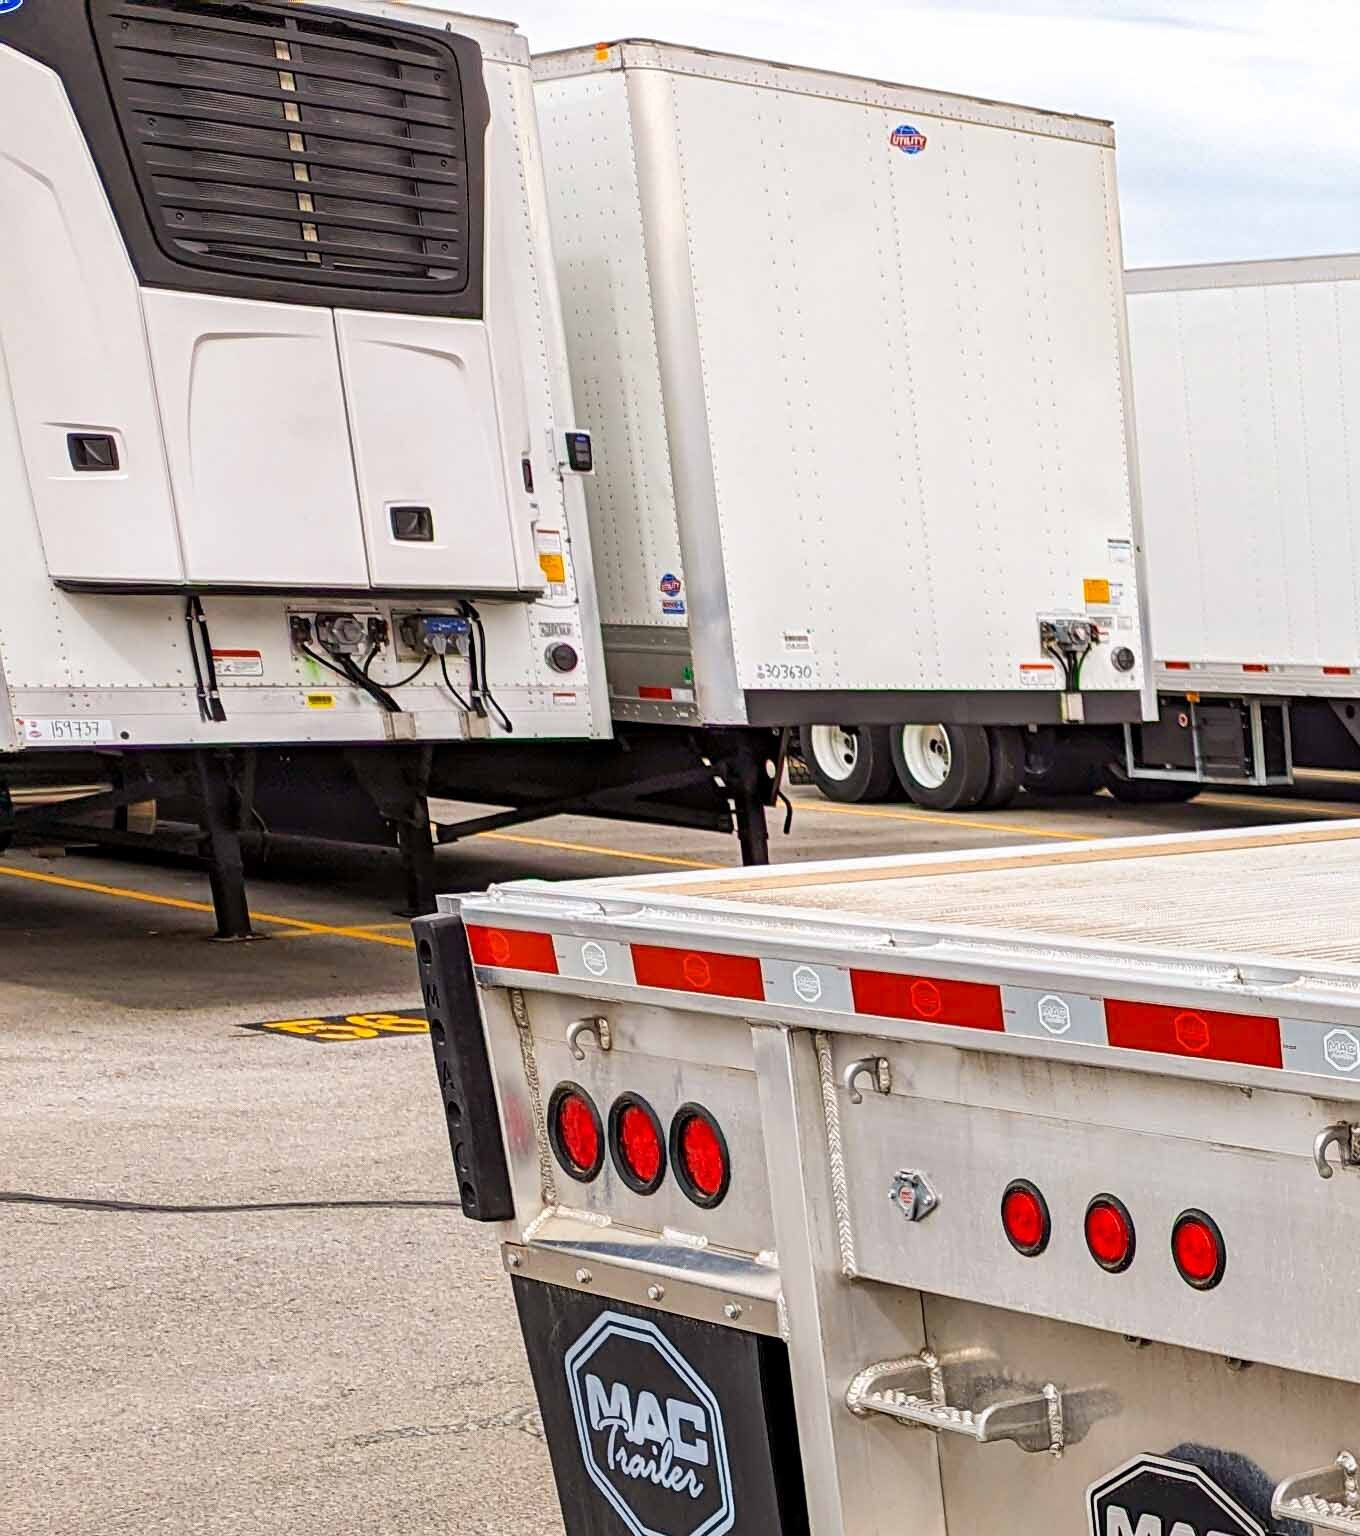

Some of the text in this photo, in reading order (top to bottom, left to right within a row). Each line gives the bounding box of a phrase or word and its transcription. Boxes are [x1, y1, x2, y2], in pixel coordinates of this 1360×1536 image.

[892, 133, 925, 149] UTILITY
[764, 663, 812, 680] 303630
[50, 720, 99, 739] 159737
[585, 1373, 709, 1466] MAC
[597, 1415, 704, 1499] Trailer
